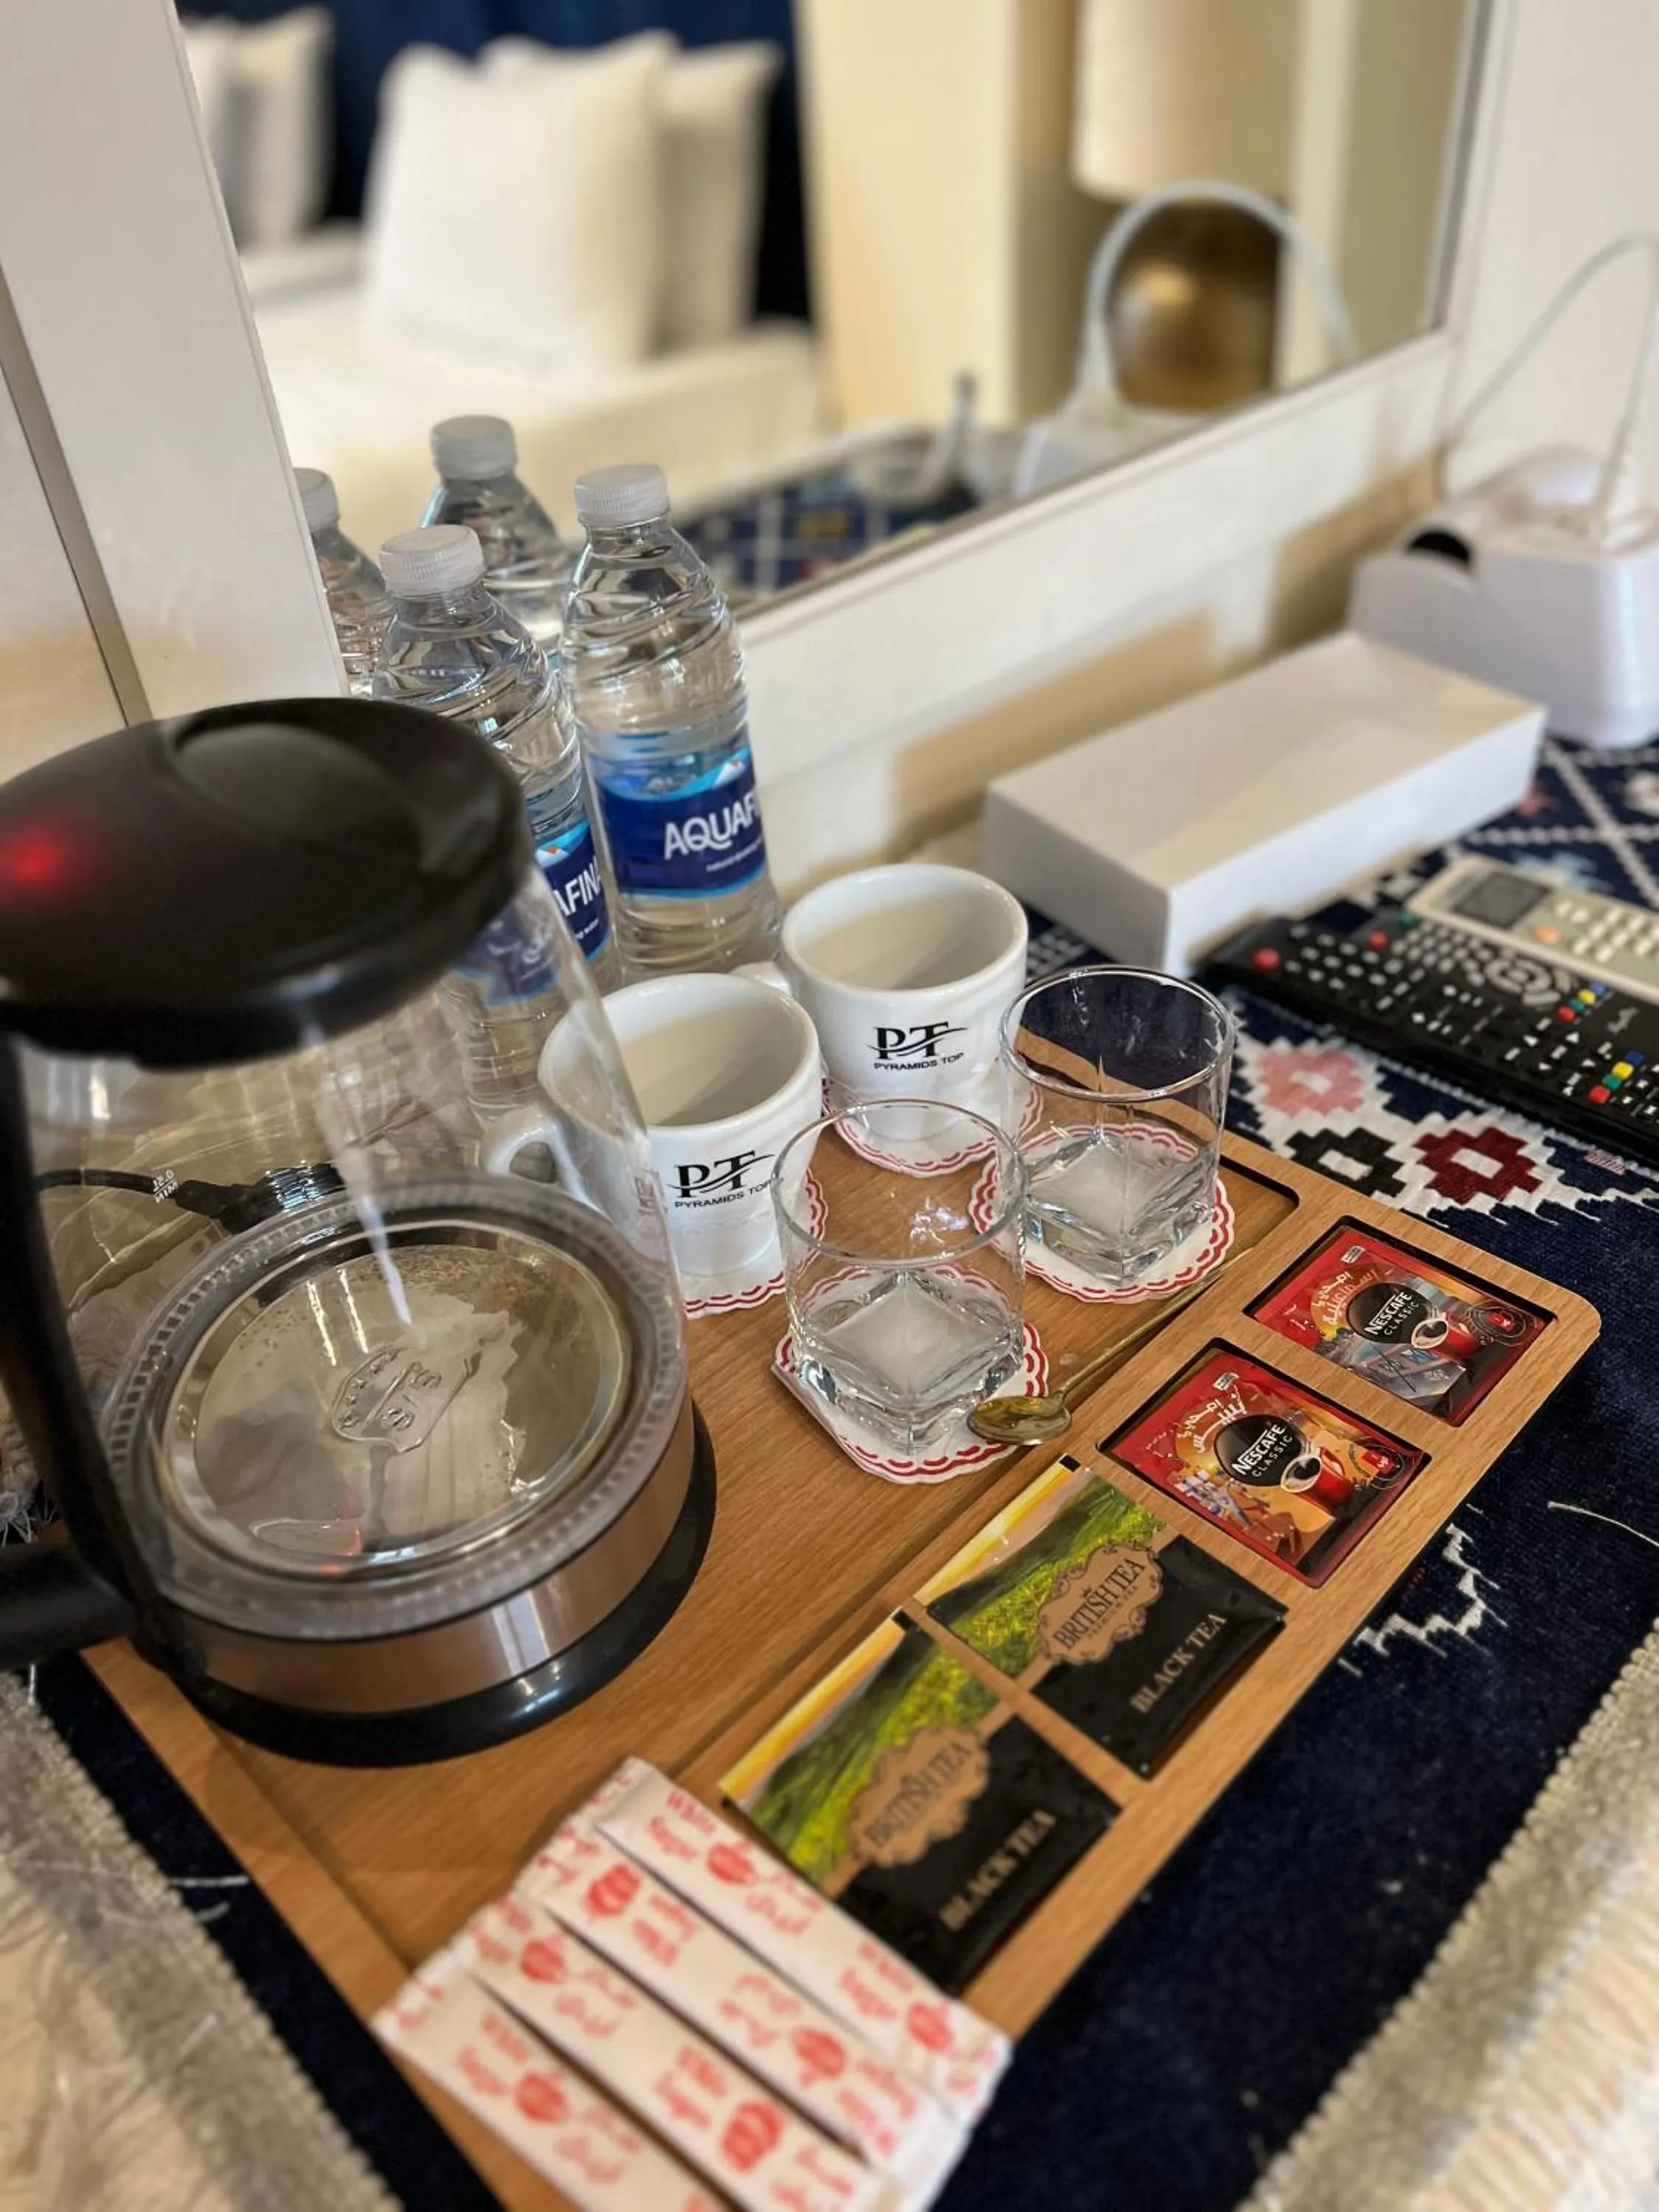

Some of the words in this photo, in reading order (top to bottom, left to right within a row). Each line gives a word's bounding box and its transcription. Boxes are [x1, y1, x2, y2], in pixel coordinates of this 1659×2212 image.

[874, 1059, 938, 1071] PYRAMIDS
[941, 1051, 964, 1065] TOP
[675, 1191, 744, 1208] PYRAMIDS
[1384, 1301, 1419, 1335] CLASSIC
[1252, 1434, 1293, 1477] CLASSIC
[1052, 1583, 1119, 1650] BRITISH
[1104, 1558, 1146, 1593] TEA
[1130, 1646, 1194, 1714] BLACK
[1185, 1613, 1227, 1649] TEA
